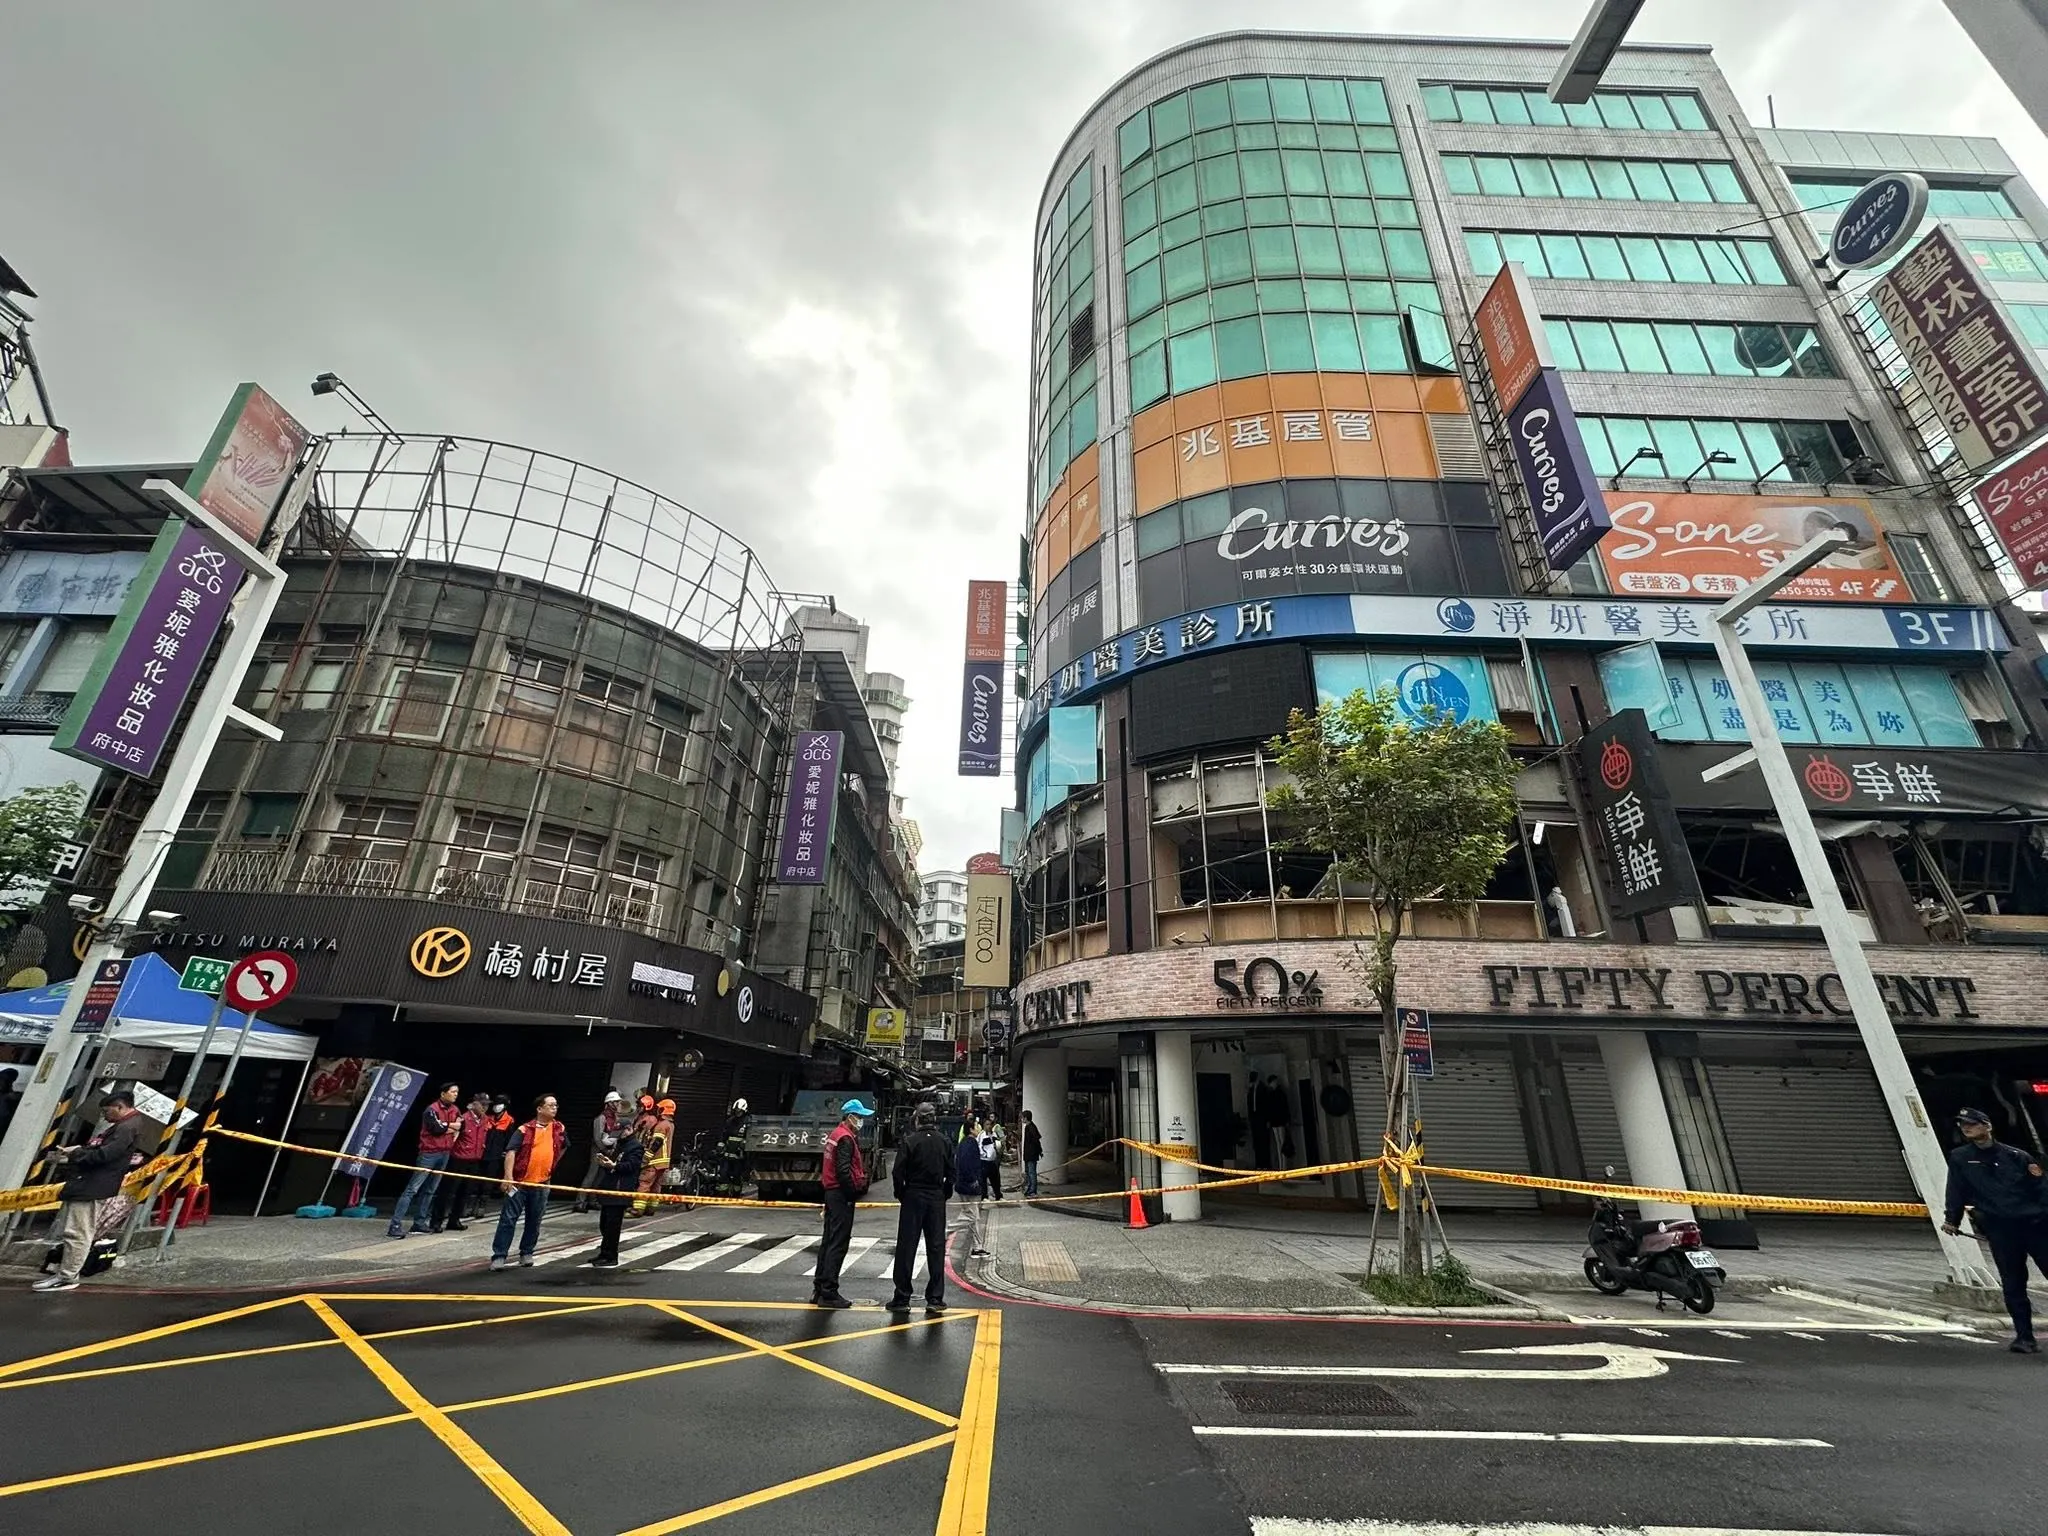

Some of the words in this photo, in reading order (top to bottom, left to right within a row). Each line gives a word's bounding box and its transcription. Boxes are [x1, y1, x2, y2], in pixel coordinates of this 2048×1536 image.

[1837, 184, 1898, 251] Curves
[1869, 224, 1892, 251] 4F
[1181, 411, 1372, 462] 兆基屋管
[1985, 389, 2044, 449] 5F
[1521, 407, 1565, 515] Curves
[1988, 466, 2048, 516] S-on
[2024, 488, 2048, 507] SP
[1217, 507, 1410, 561] Curves
[1610, 501, 1779, 560] S-one
[1628, 575, 1682, 591] 岩盤浴
[1840, 580, 1864, 595] 4F
[2033, 560, 2048, 576] 4
[1899, 611, 1955, 646] 3F
[116, 587, 202, 736] 愛妮雅化妝品
[968, 674, 998, 744] Curves
[91, 732, 146, 764] 府中店
[796, 765, 822, 861] 愛妮雅化妝品
[786, 867, 816, 877] 府中店
[970, 856, 999, 870] S-on
[1603, 806, 1619, 842] SUSHI
[1614, 844, 1634, 896] EXPRESS
[153, 933, 224, 947] KITSU
[239, 936, 338, 950] MURAYA
[485, 940, 608, 986] 橘村屋
[193, 961, 225, 974] 重慶路
[1213, 957, 1324, 998] 50%
[1482, 964, 1675, 1010] FIFTY
[1022, 980, 1091, 1027] CENT
[1216, 996, 1256, 1010] FIFTY
[1260, 995, 1325, 1009] PERCENT
